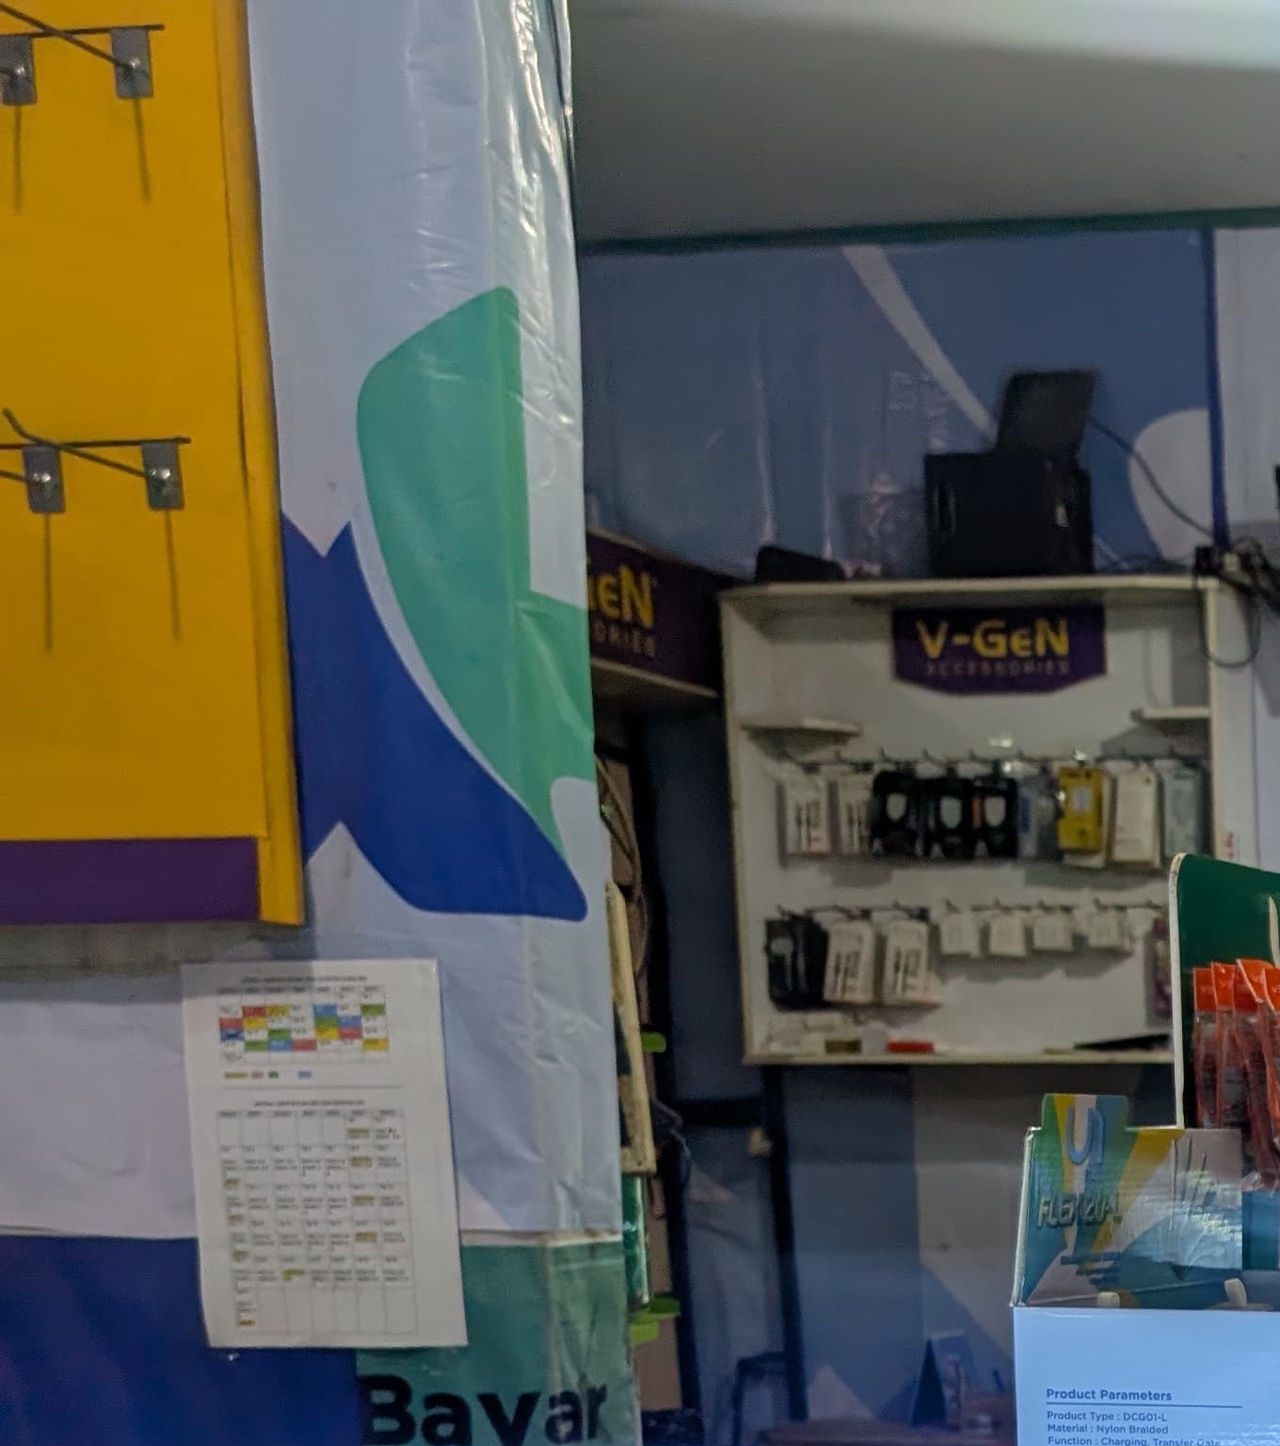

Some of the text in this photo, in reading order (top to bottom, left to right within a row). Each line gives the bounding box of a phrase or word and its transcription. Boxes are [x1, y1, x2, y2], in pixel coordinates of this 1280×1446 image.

[1046, 1388, 1172, 1401] Product Parameters
[1047, 1410, 1087, 1421] Product
[1091, 1412, 1115, 1422] Type
[1047, 1423, 1169, 1435] Material Nylon Braided
[1048, 1436, 1092, 1446] Function
[1101, 1437, 1150, 1446] Charging,
